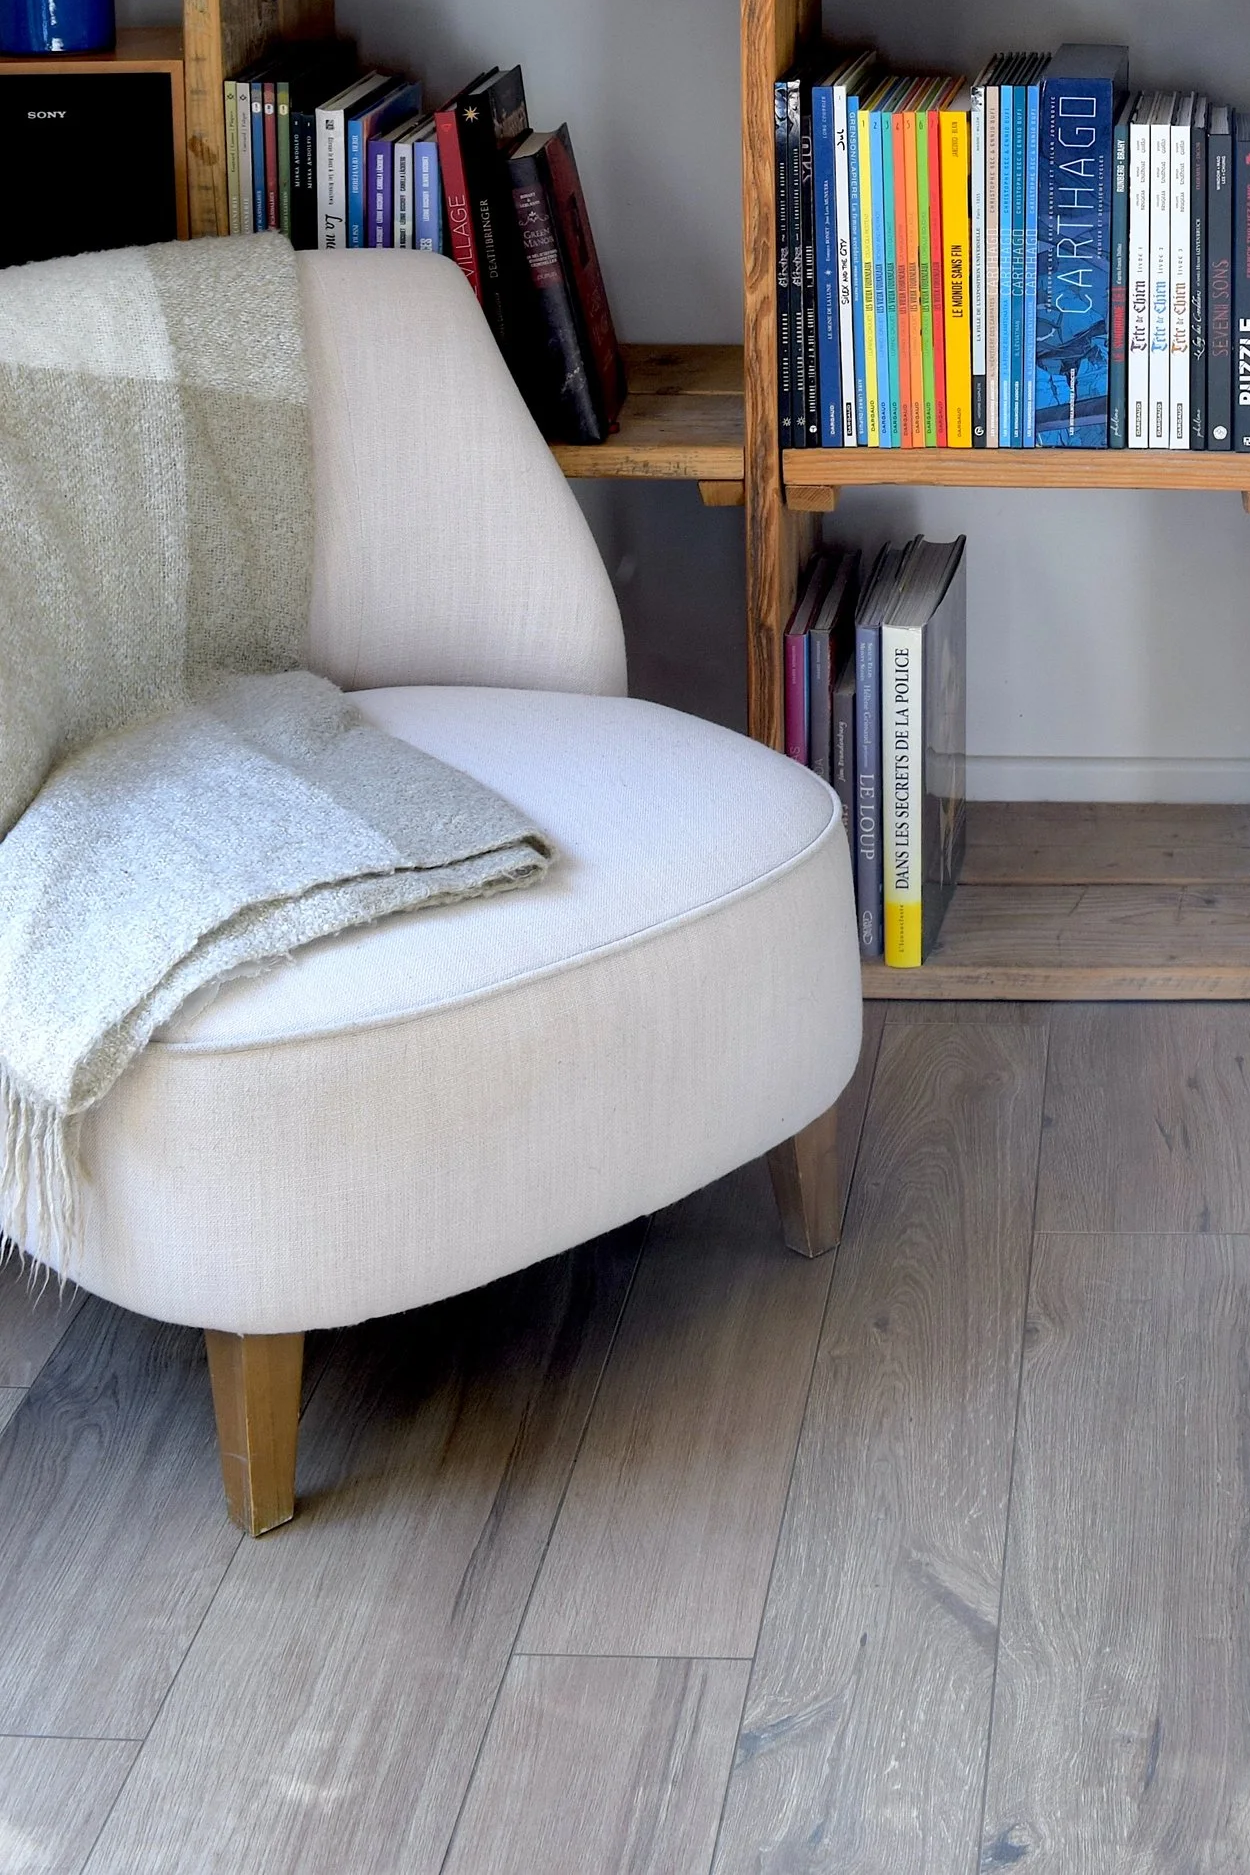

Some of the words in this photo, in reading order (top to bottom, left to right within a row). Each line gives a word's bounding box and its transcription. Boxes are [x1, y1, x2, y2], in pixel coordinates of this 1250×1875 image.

[27, 110, 66, 119] SONY
[1117, 139, 1126, 161] BRAHY
[1117, 165, 1125, 193] RUNBERG
[1056, 96, 1097, 314] CARTHAGO
[448, 194, 476, 278] VILLAGE
[479, 199, 499, 279] DEATHBRINGER
[951, 244, 962, 257] FIN
[951, 260, 962, 279] SANS
[1012, 229, 1023, 297] CARTHAGO
[1211, 257, 1230, 300] SONS
[952, 281, 963, 307] MONDE
[1132, 280, 1148, 313] Chien
[1153, 281, 1169, 314] Chien
[1173, 283, 1189, 316] Chien
[952, 309, 963, 318] LE
[894, 648, 909, 705] POLICE
[863, 684, 872, 709] Hélène
[861, 711, 871, 744] Grimaud
[895, 708, 909, 727] LA
[834, 721, 847, 766] Brandenburg
[895, 730, 909, 751] DE
[860, 773, 875, 798] LE
[895, 755, 909, 819] SECRETS
[859, 804, 875, 860] LOUP
[895, 822, 909, 847] LES
[895, 851, 909, 890] DANS
